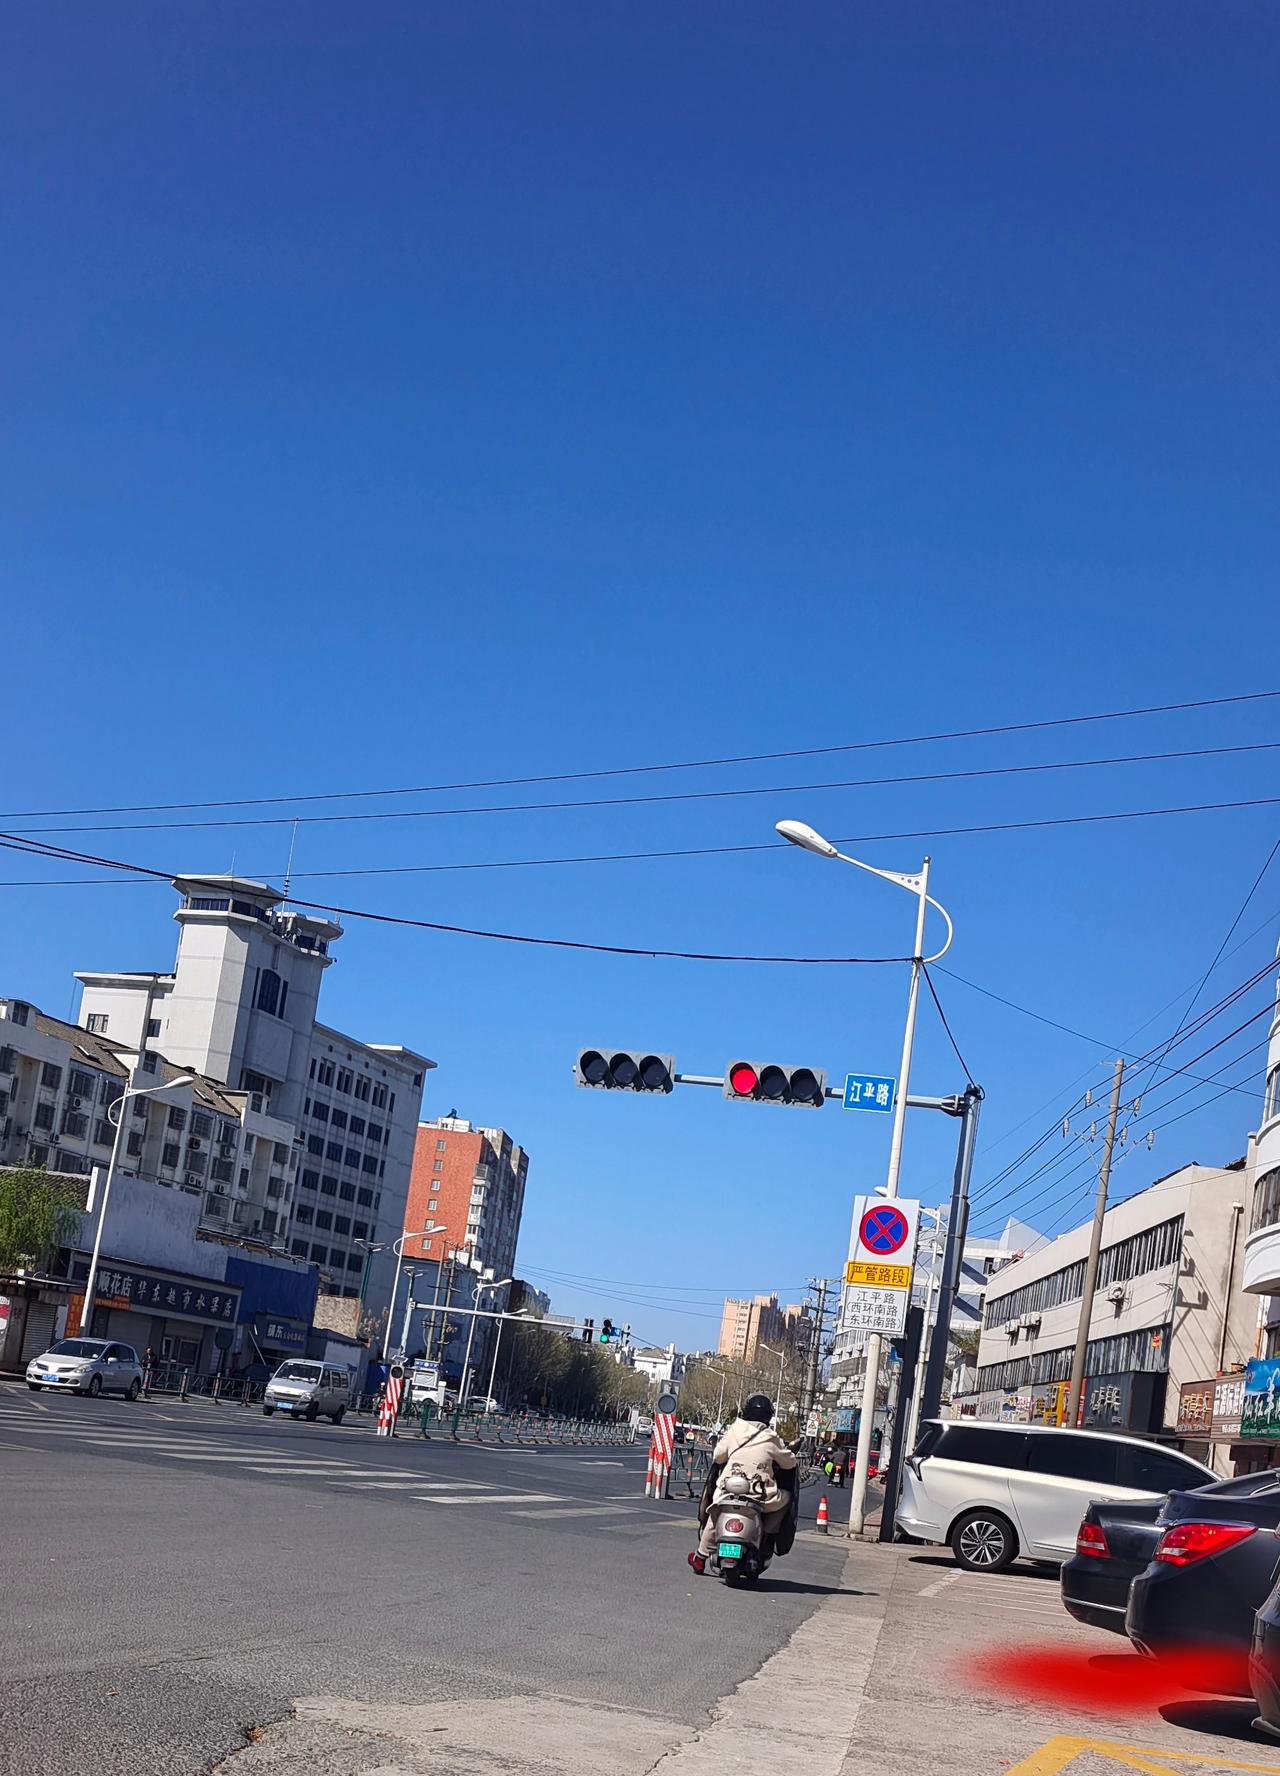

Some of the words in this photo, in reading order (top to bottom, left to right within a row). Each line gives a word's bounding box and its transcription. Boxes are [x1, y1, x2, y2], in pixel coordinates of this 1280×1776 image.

[849, 1081, 890, 1106] 江平路
[87, 1270, 133, 1296] 顺花店
[850, 1265, 905, 1284] 严管路段
[136, 1280, 233, 1317] 华东超市水果店
[856, 1291, 895, 1304] 江平路
